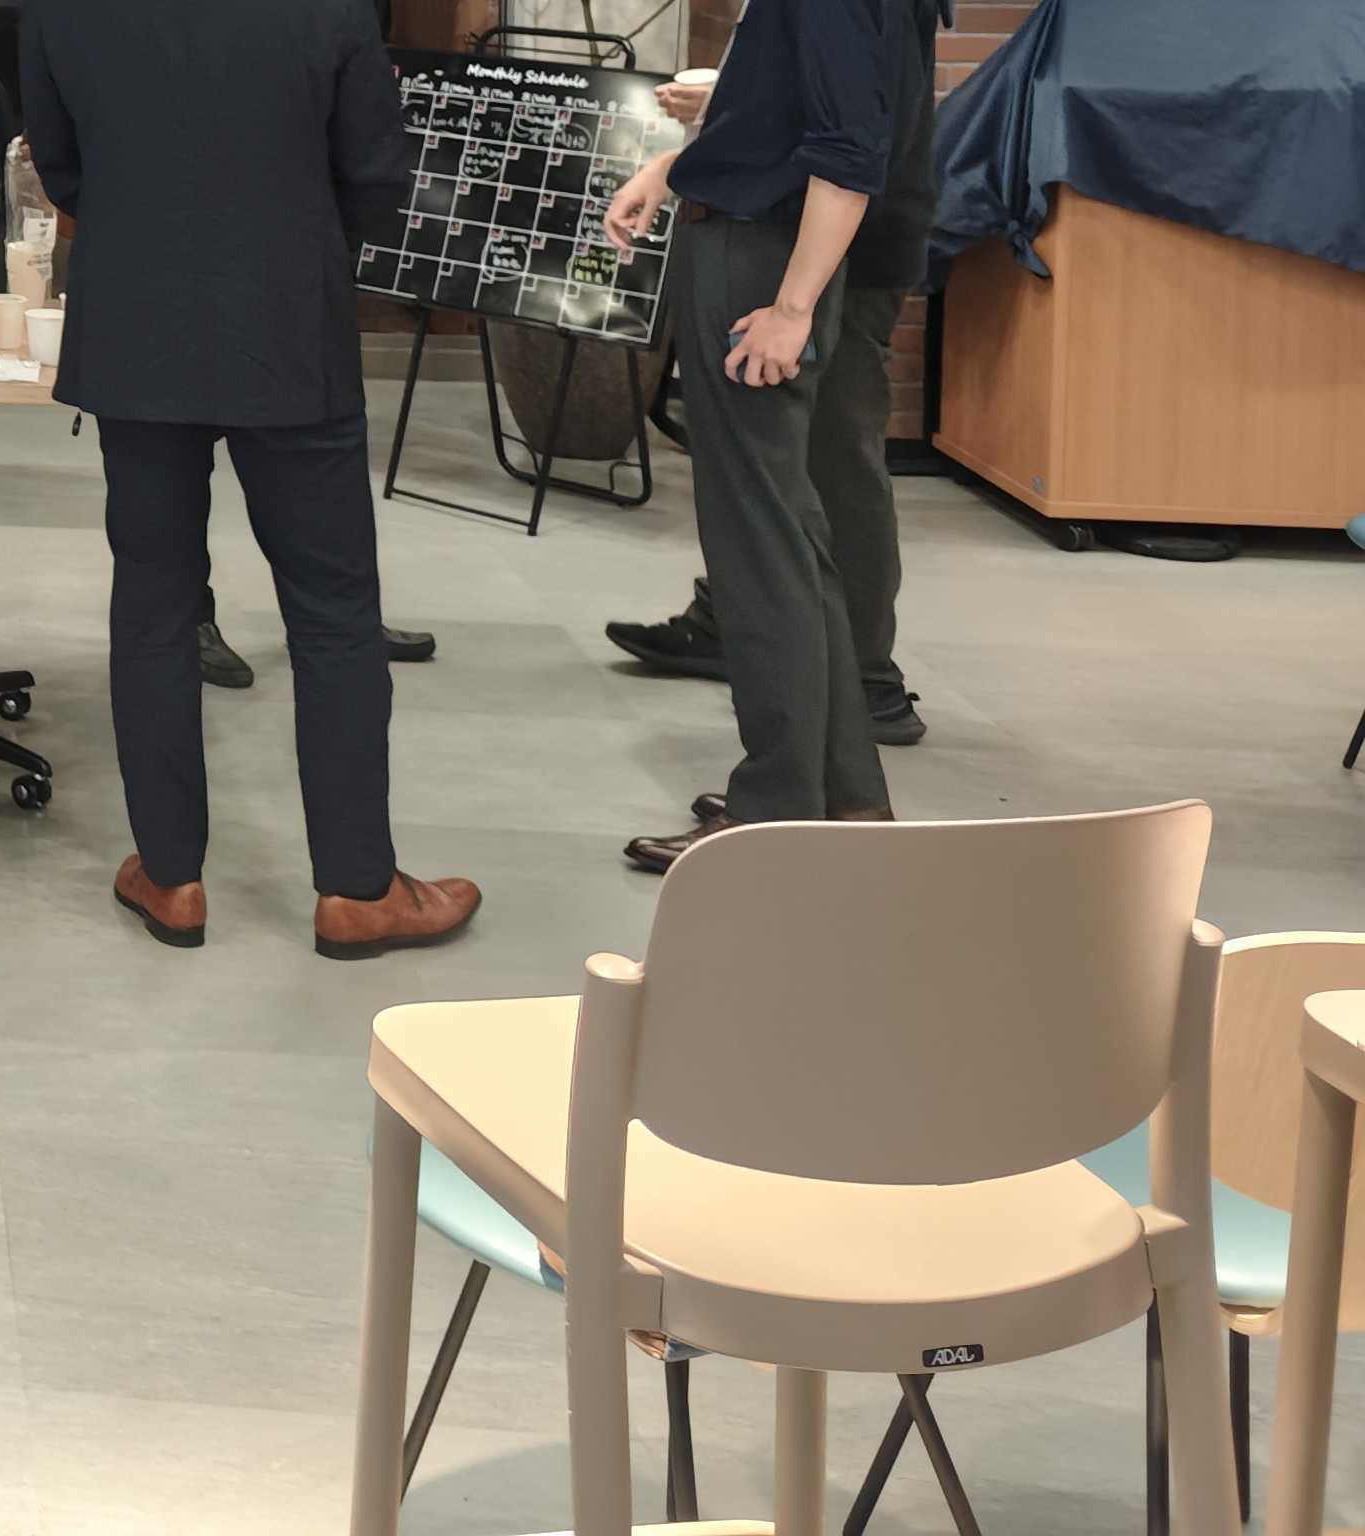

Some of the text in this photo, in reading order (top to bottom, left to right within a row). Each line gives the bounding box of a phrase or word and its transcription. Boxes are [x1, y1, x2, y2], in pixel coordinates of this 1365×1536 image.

[467, 63, 589, 89] Monthly Schedule
[931, 1346, 975, 1365] ADAL
